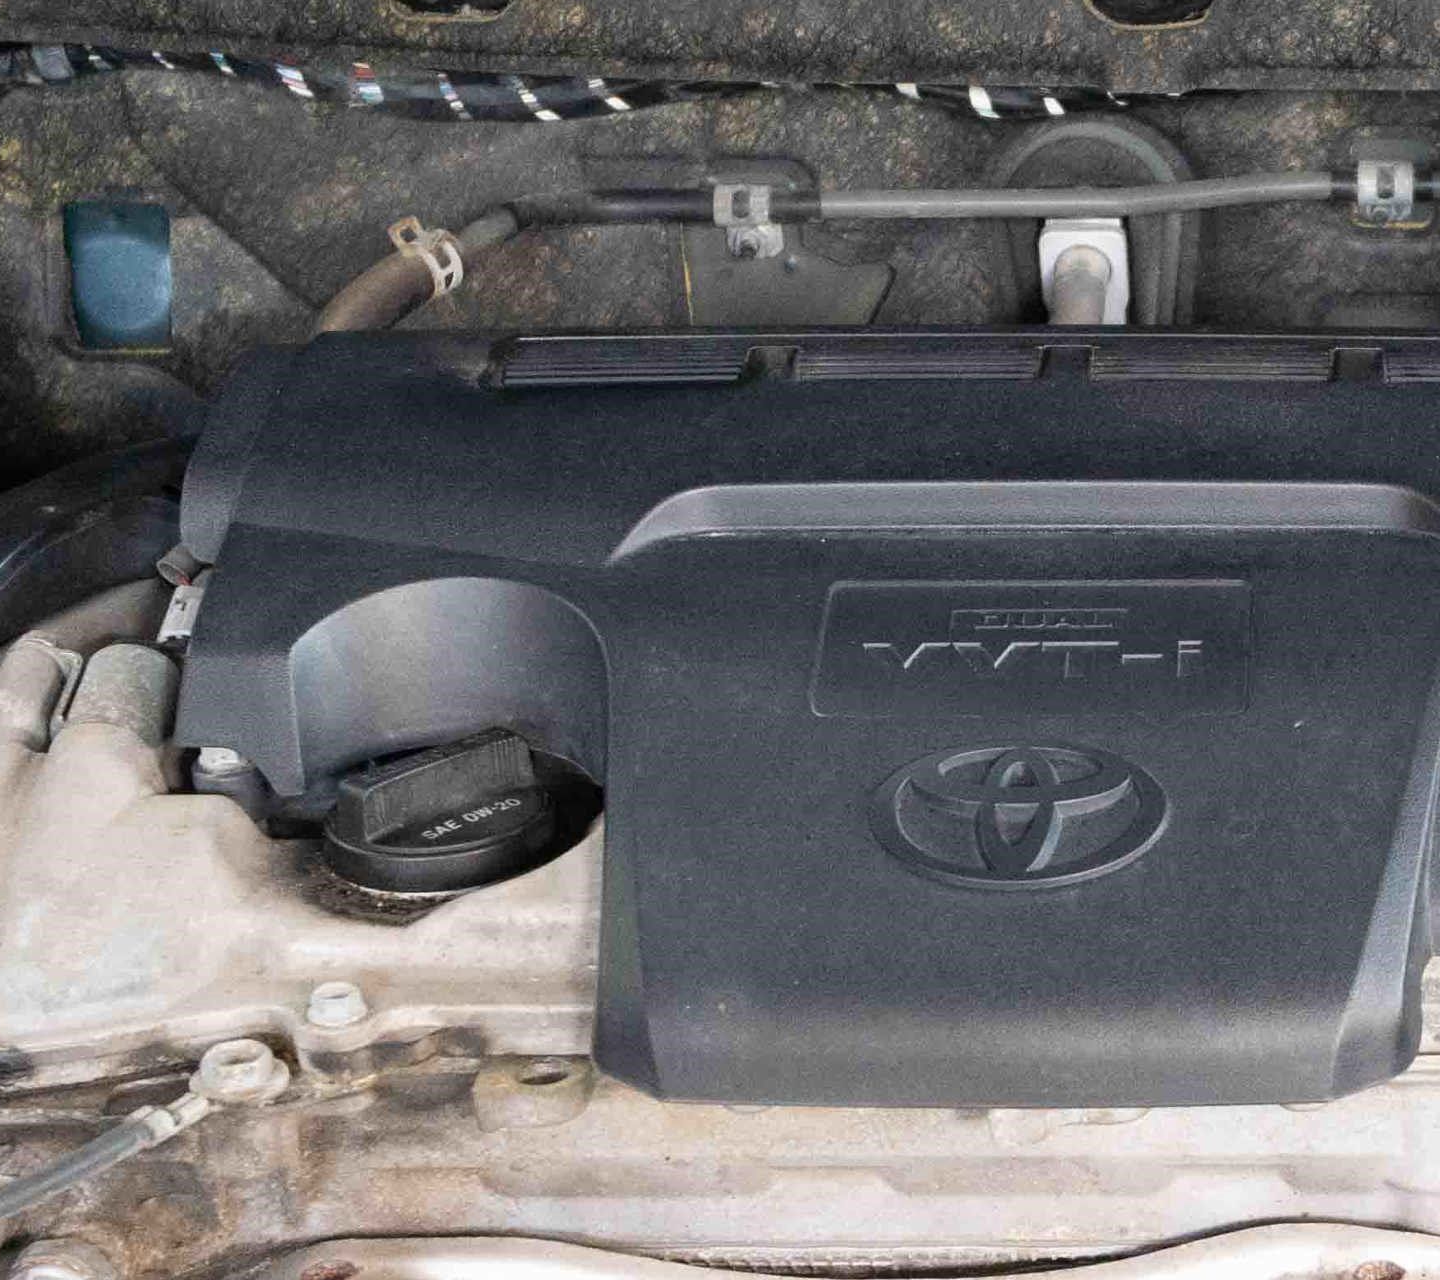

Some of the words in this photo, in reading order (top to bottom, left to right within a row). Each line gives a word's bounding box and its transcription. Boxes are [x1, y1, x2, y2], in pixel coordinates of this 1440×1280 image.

[974, 611, 1114, 631] DUAL
[421, 818, 462, 841] SAE
[462, 797, 523, 825] 0W-20
